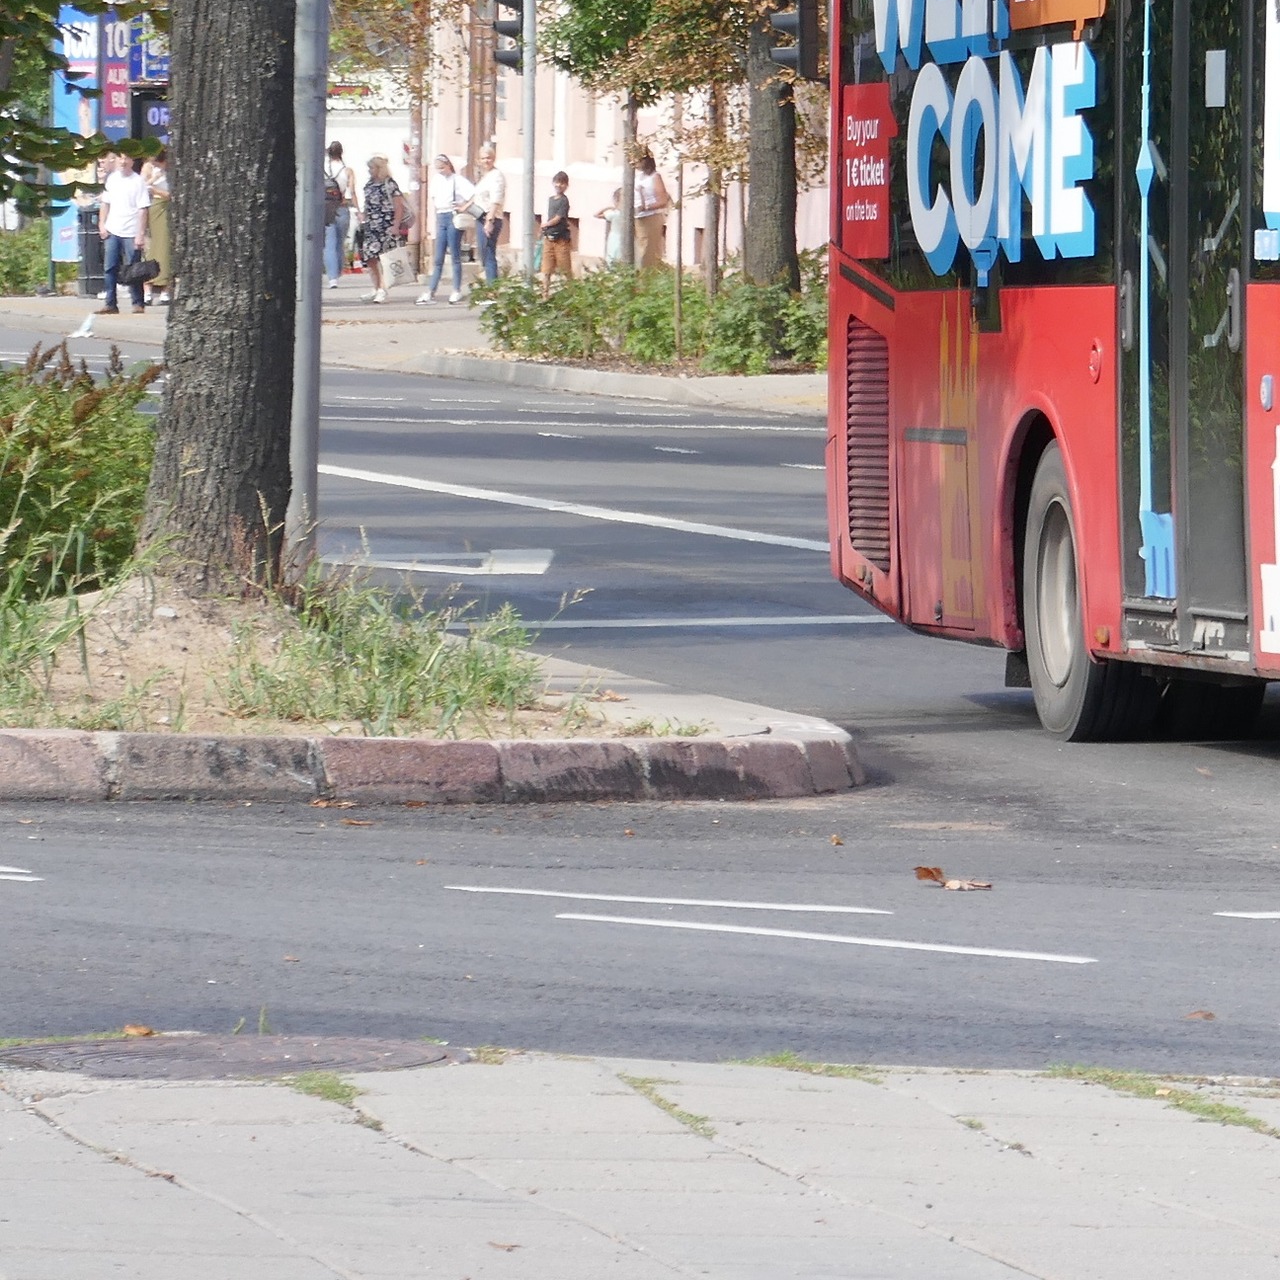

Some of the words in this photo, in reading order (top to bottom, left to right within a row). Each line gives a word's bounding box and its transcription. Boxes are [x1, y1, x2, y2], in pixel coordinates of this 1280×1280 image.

[847, 116, 861, 147] Buy
[860, 118, 879, 147] your
[860, 154, 885, 187] ticket
[907, 41, 1096, 274] COME
[846, 204, 854, 221] on
[854, 199, 866, 221] the
[865, 199, 878, 221] bus
